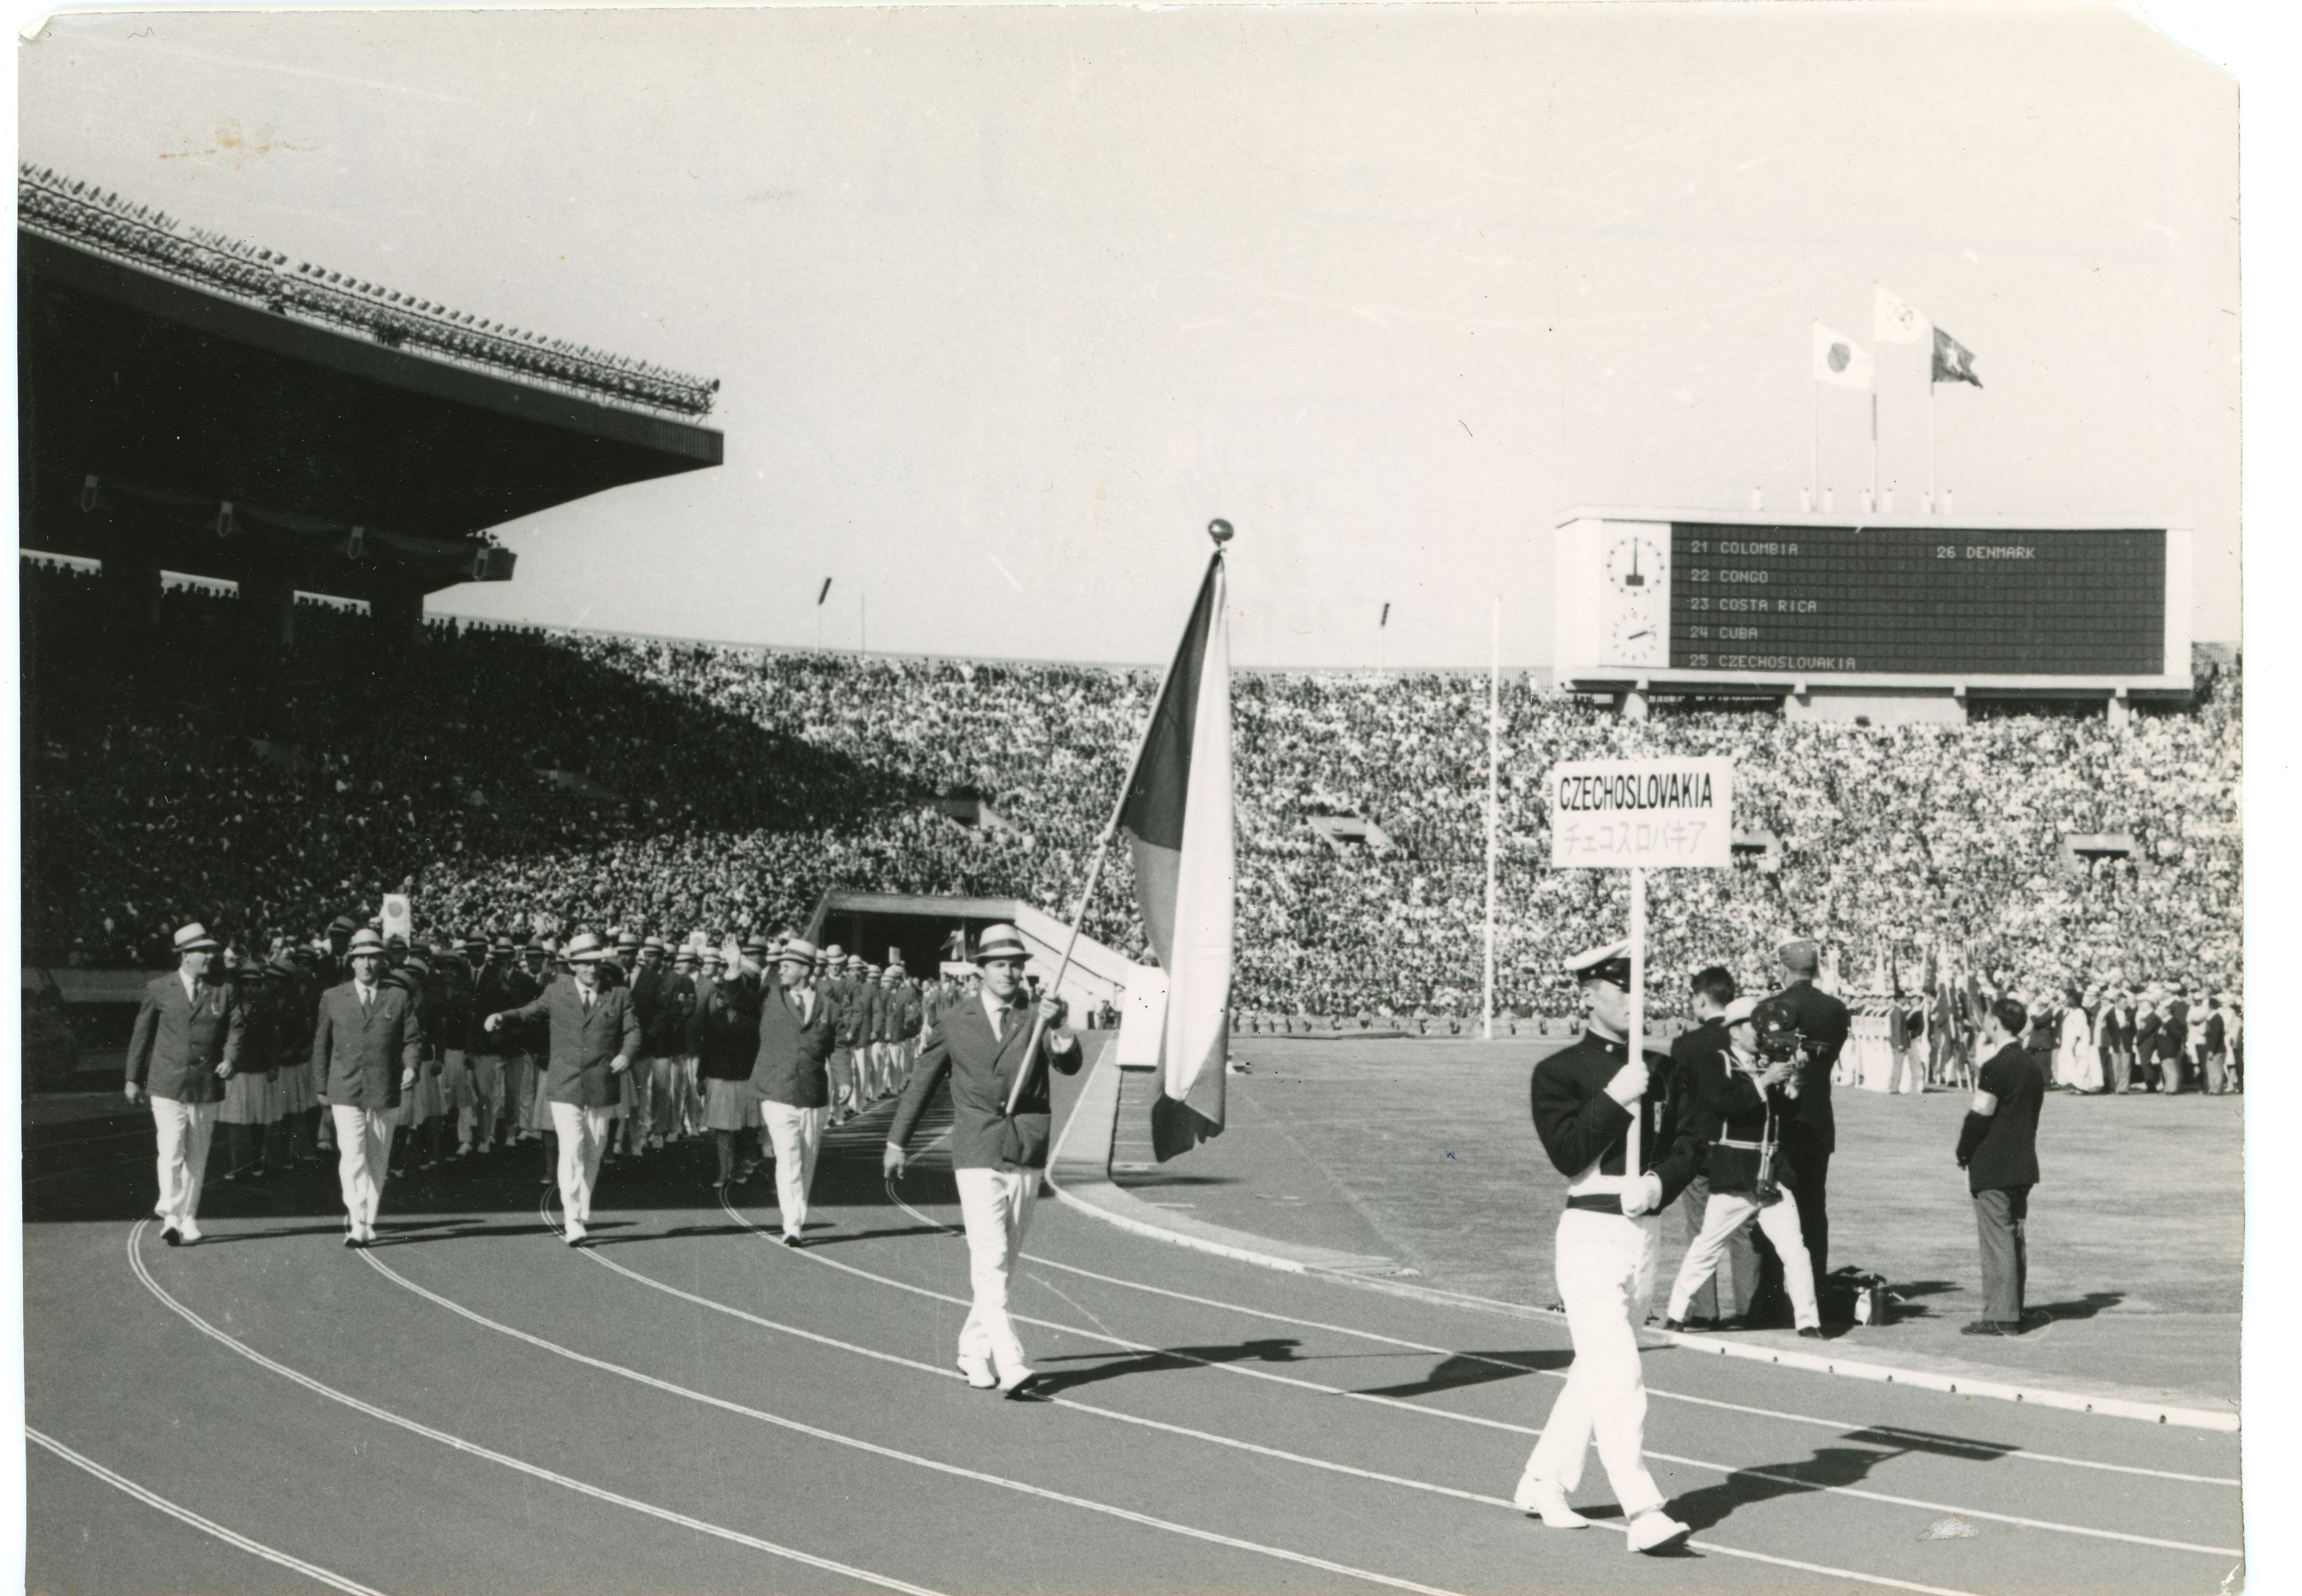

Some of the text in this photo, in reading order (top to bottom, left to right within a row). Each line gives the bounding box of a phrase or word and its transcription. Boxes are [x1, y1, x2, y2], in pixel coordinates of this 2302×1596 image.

[1691, 540, 1798, 556] 21 COLOMBIA
[1936, 546, 2036, 559] 26 DENMARK
[1691, 569, 1768, 584] 22 CONGO
[1690, 598, 1816, 613] 23 COSTA RICA
[1690, 626, 1758, 640] 24 CUBA
[1689, 654, 1856, 670] 25 CZECHOSLOVAKIA
[1560, 773, 1713, 811] CZECHOSLOVAKIA
[1563, 820, 1707, 855] チェコスロバキア
